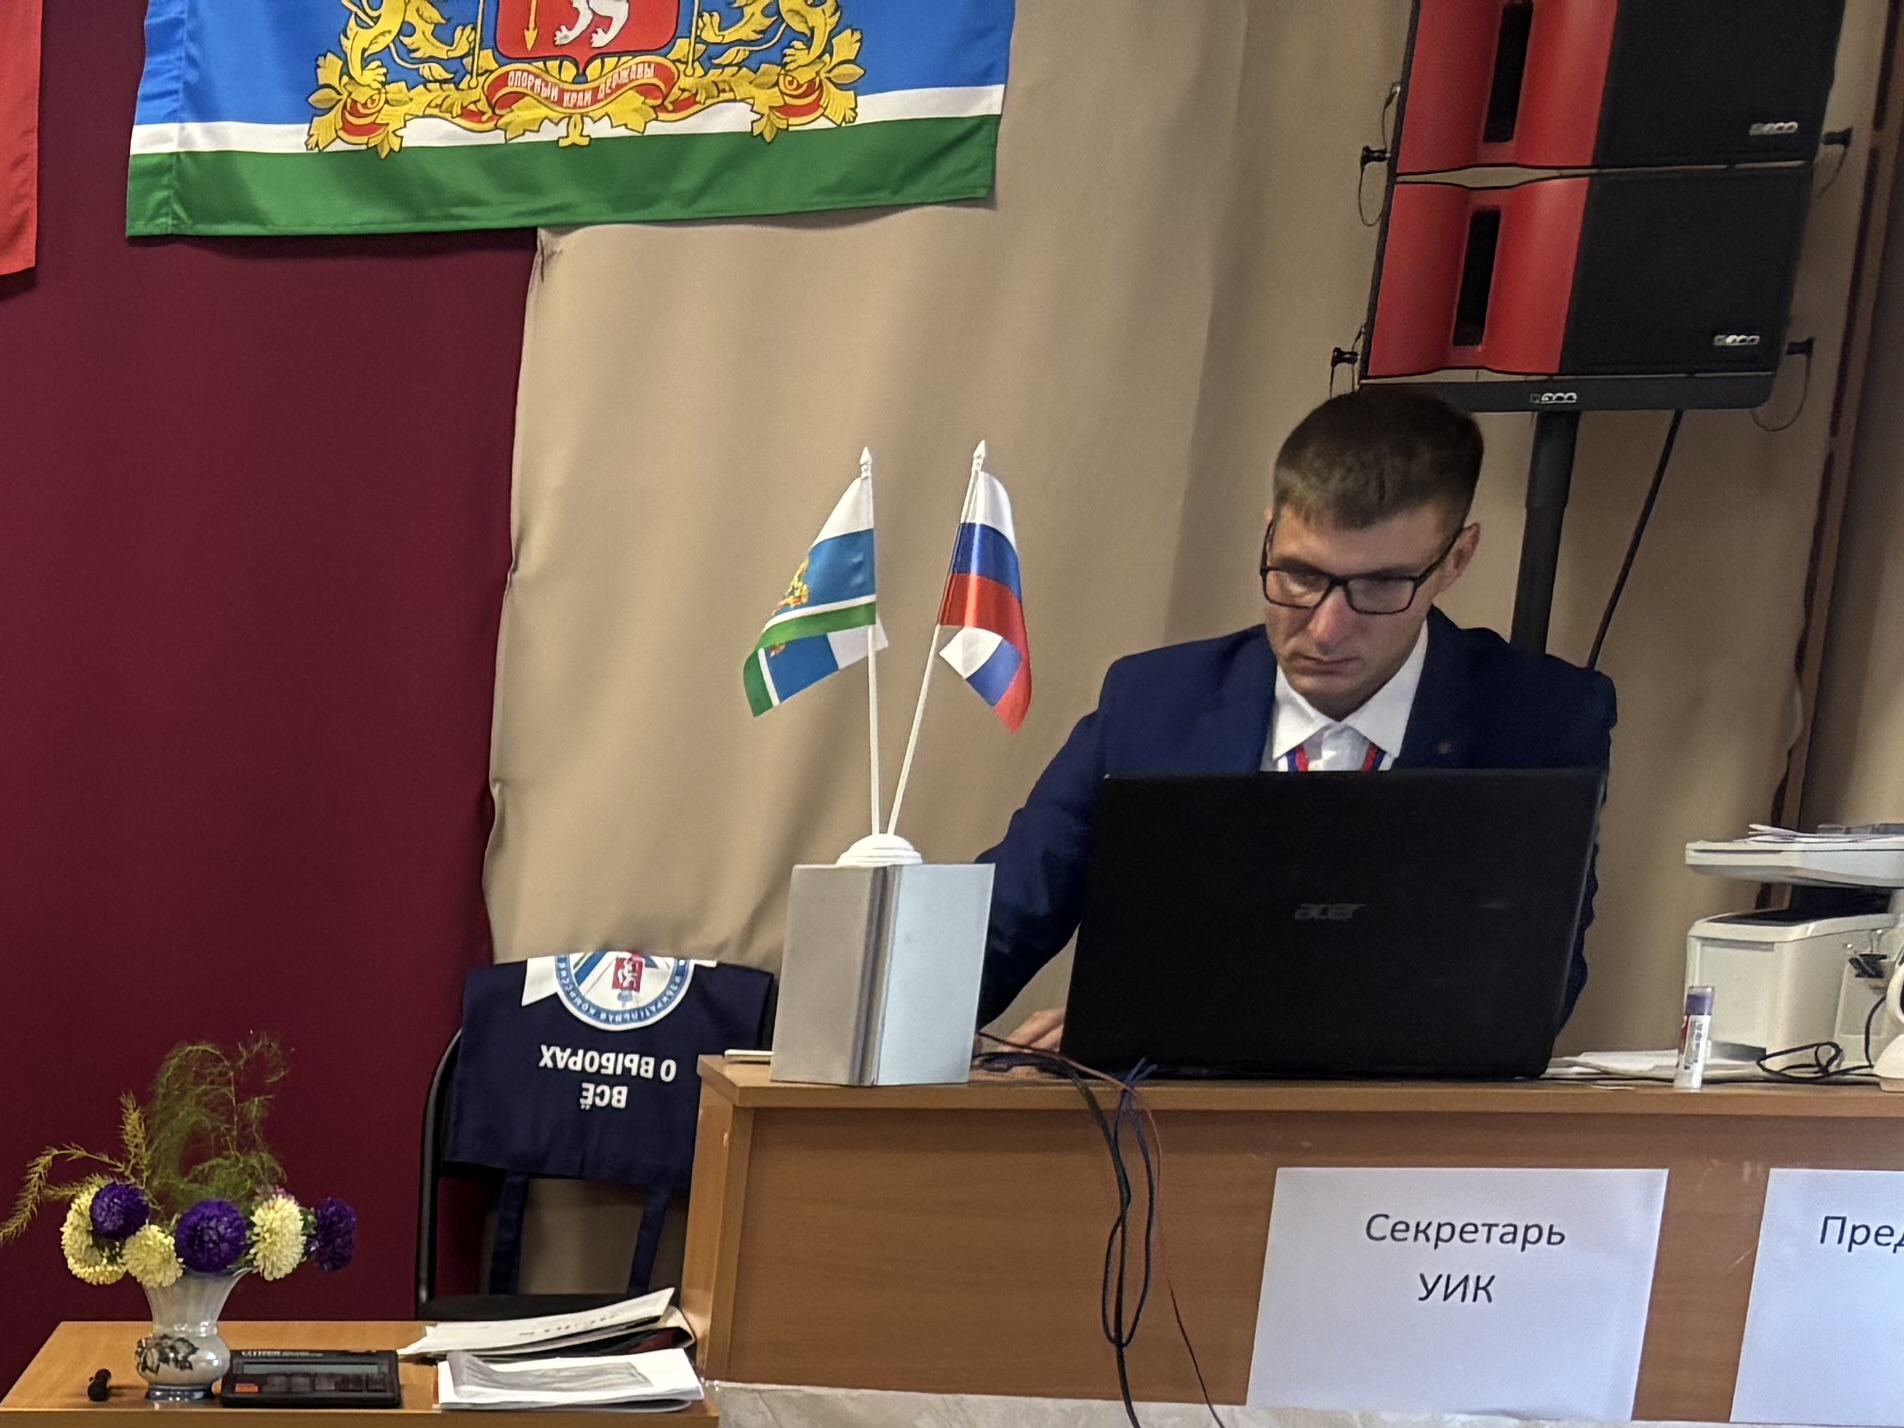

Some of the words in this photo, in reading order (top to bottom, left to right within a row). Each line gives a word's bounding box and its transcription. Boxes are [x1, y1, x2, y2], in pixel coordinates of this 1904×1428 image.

[539, 1044, 655, 1080] ВЫБОРАХ
[660, 1059, 677, 1083] О
[579, 1082, 629, 1111] ВСЁ
[1365, 1212, 1567, 1253] Секретарь
[1417, 1273, 1496, 1304] УИК
